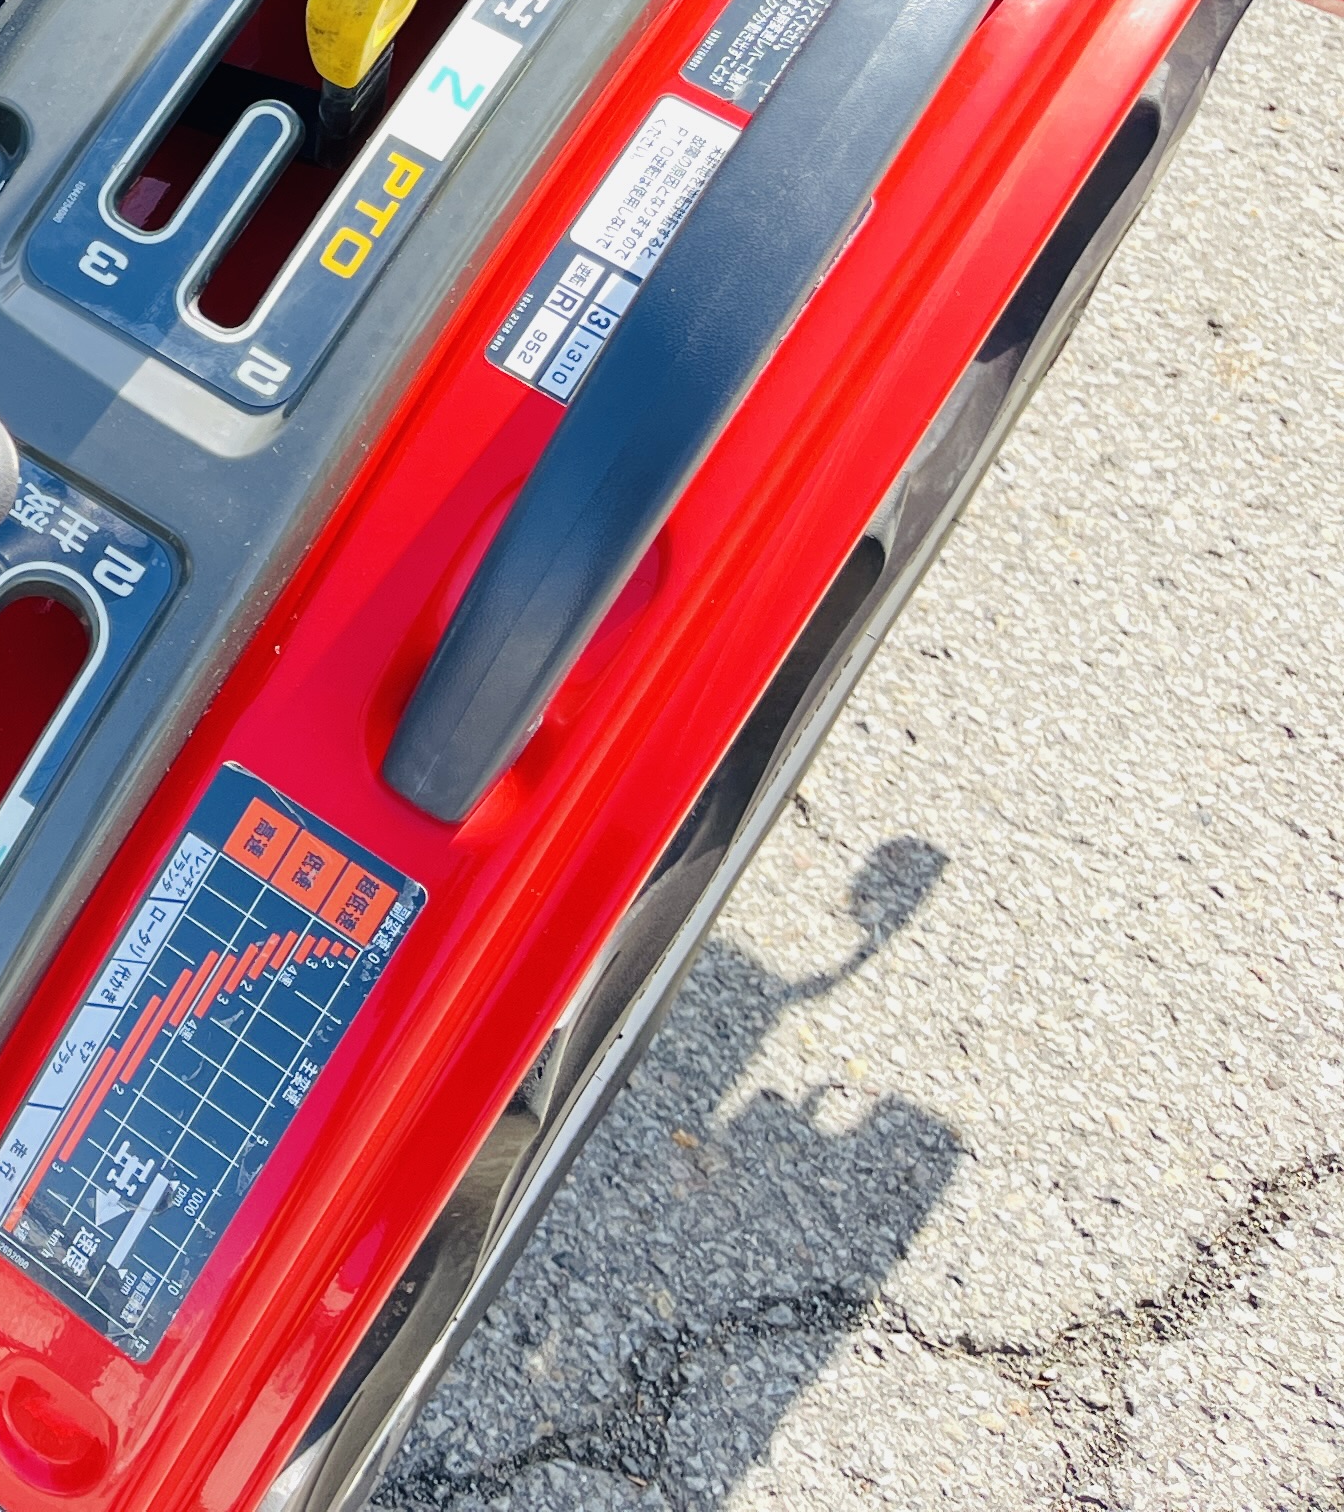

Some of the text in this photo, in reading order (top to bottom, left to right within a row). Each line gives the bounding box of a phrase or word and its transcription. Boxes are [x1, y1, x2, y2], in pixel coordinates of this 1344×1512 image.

[428, 65, 485, 112] N
[316, 151, 422, 280] PTO
[614, 134, 706, 260] 故障の原因となりますので
[79, 240, 129, 286] 3
[516, 261, 593, 365] 逆転 R 952
[551, 308, 612, 386] 3 1310
[230, 346, 292, 397] 2
[11, 481, 102, 554] 主変
[93, 545, 145, 597] 2
[242, 818, 277, 858] 高速
[175, 846, 211, 897] トレンチャ
[291, 851, 326, 891] 低速
[334, 874, 381, 933] 超低速
[371, 901, 408, 950] 副変速
[127, 907, 165, 959] ロータリ
[99, 964, 132, 1004] 代かき
[277, 963, 298, 987] 4速
[77, 1038, 97, 1062] モア
[178, 1018, 198, 1041] 4速
[281, 1057, 318, 1106] 主変速
[254, 1135, 268, 1146] 5
[50, 1161, 63, 1172] 3
[170, 1183, 190, 1206] rpm
[182, 1187, 206, 1217] 1000
[39, 1228, 64, 1258] km/h
[59, 1225, 101, 1276] 速度
[118, 1272, 138, 1295] rpm
[165, 1279, 182, 1296] 10
